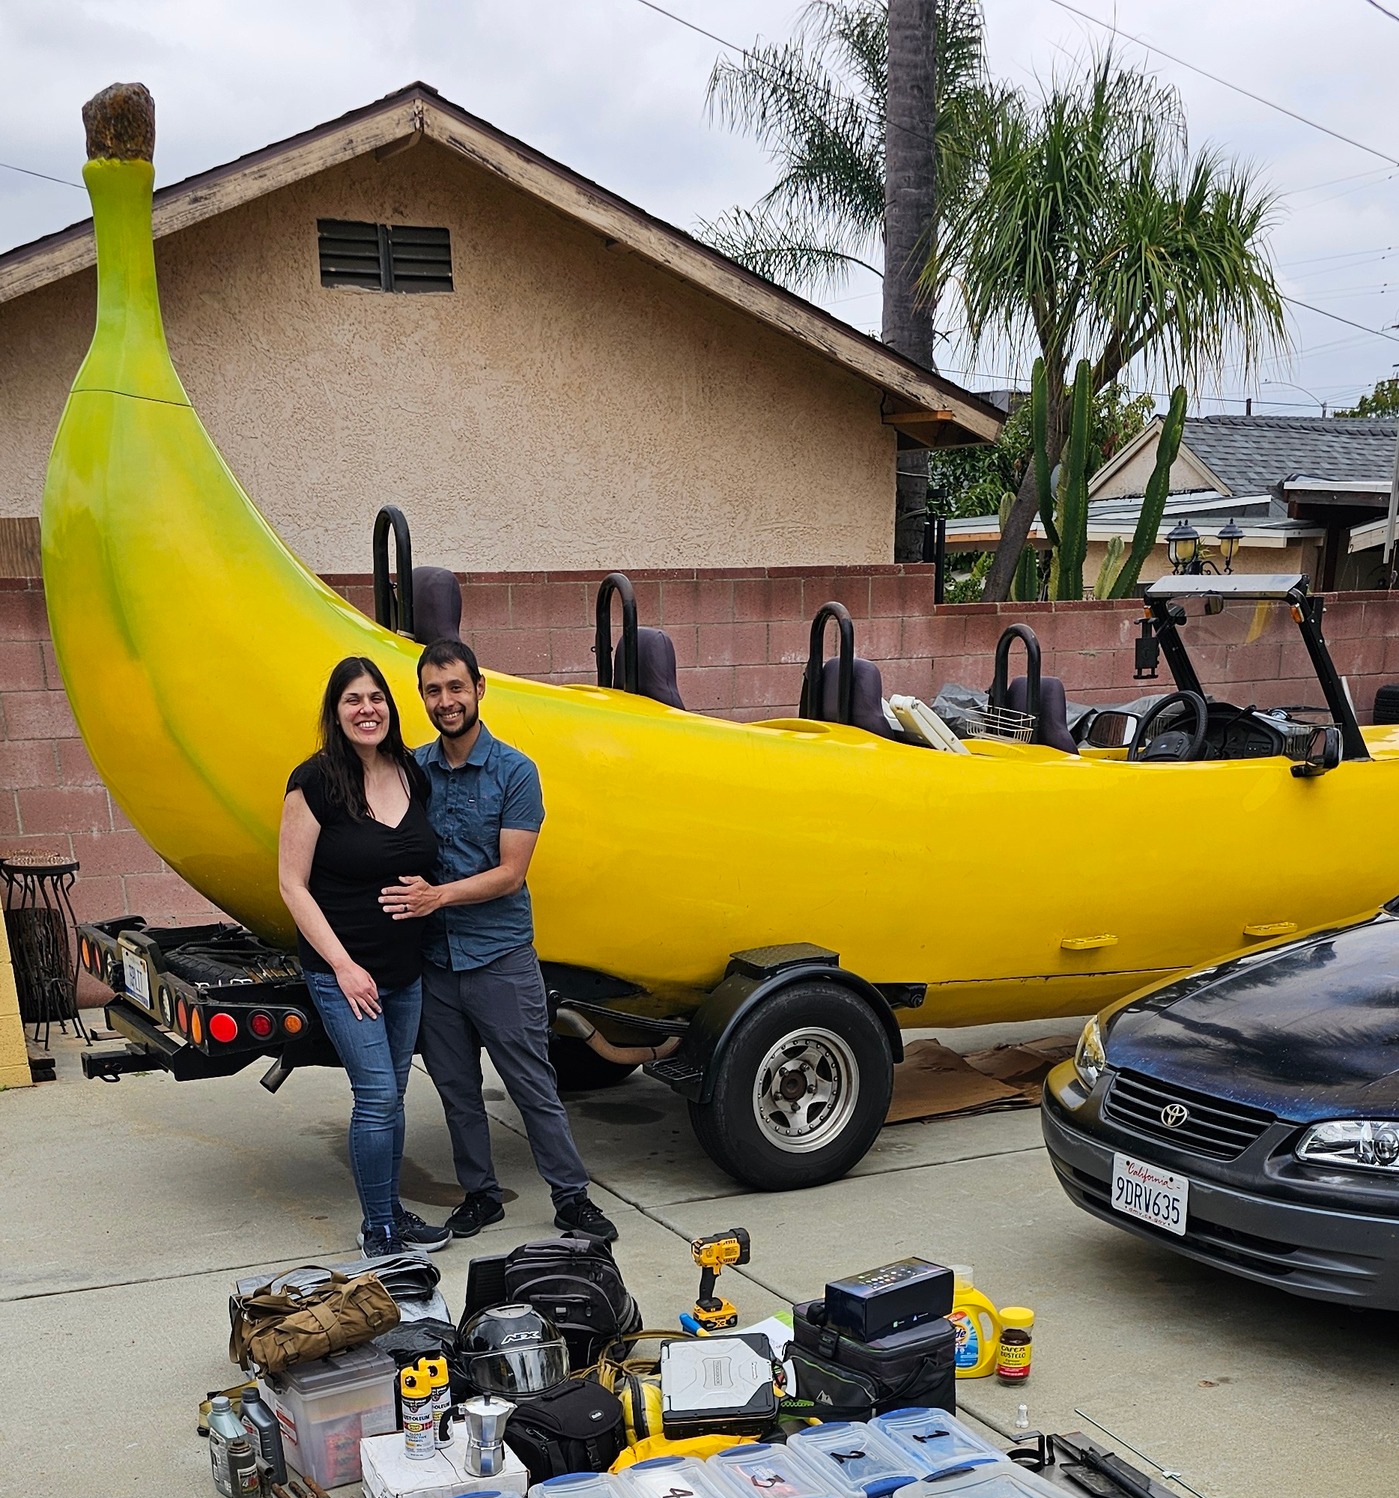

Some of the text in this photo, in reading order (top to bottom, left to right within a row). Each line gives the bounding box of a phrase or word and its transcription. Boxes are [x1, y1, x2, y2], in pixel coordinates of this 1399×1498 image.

[1128, 1162, 1173, 1190] California
[1115, 1176, 1180, 1225] 9DRV635
[501, 1331, 541, 1345] AFX
[912, 1430, 950, 1443] 1
[830, 1450, 866, 1464] 2
